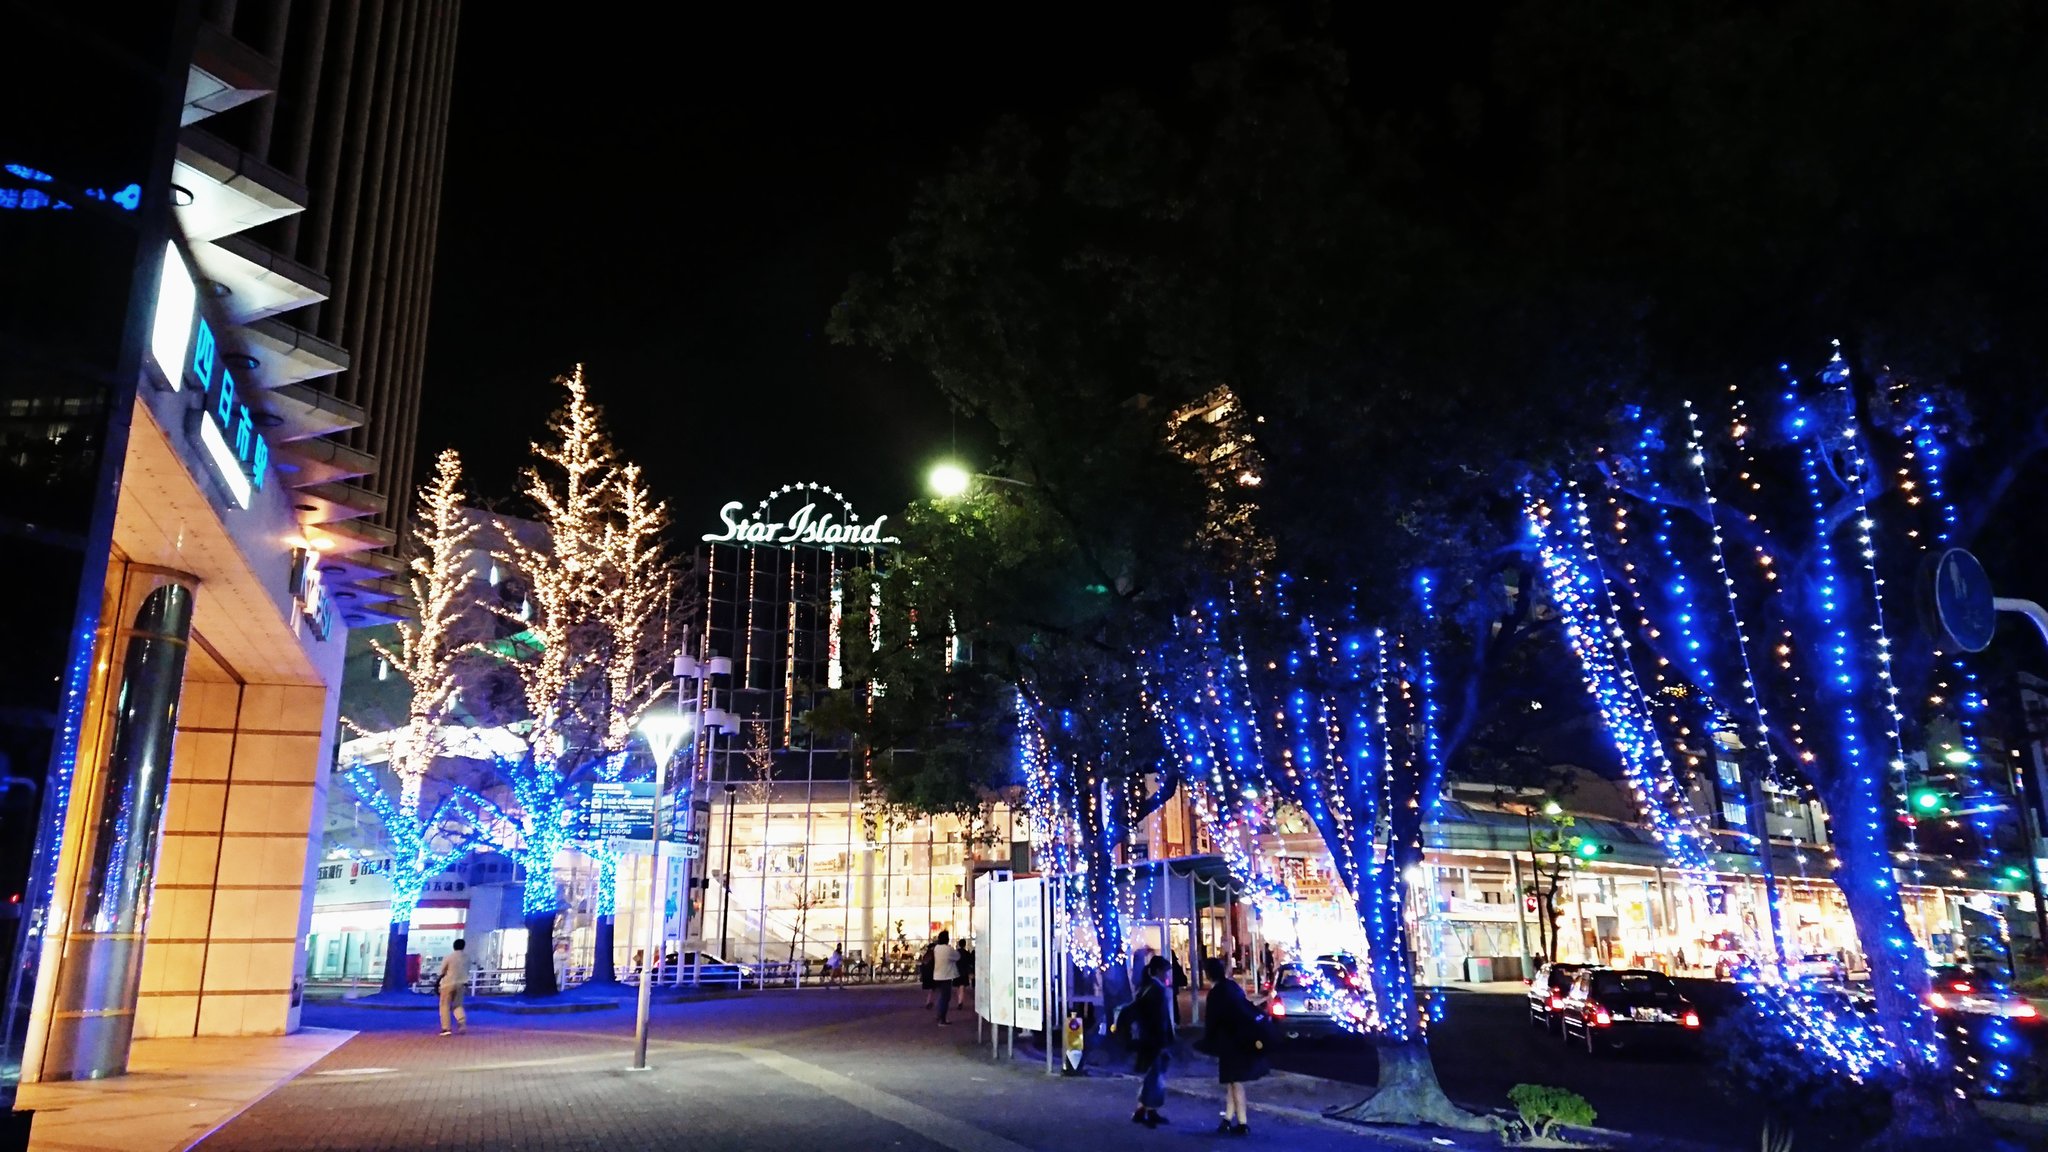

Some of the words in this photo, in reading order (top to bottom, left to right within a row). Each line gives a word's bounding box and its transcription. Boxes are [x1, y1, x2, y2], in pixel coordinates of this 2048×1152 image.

[193, 317, 268, 491] 四日市駅
[702, 501, 784, 542] Star
[779, 503, 888, 543] Island
